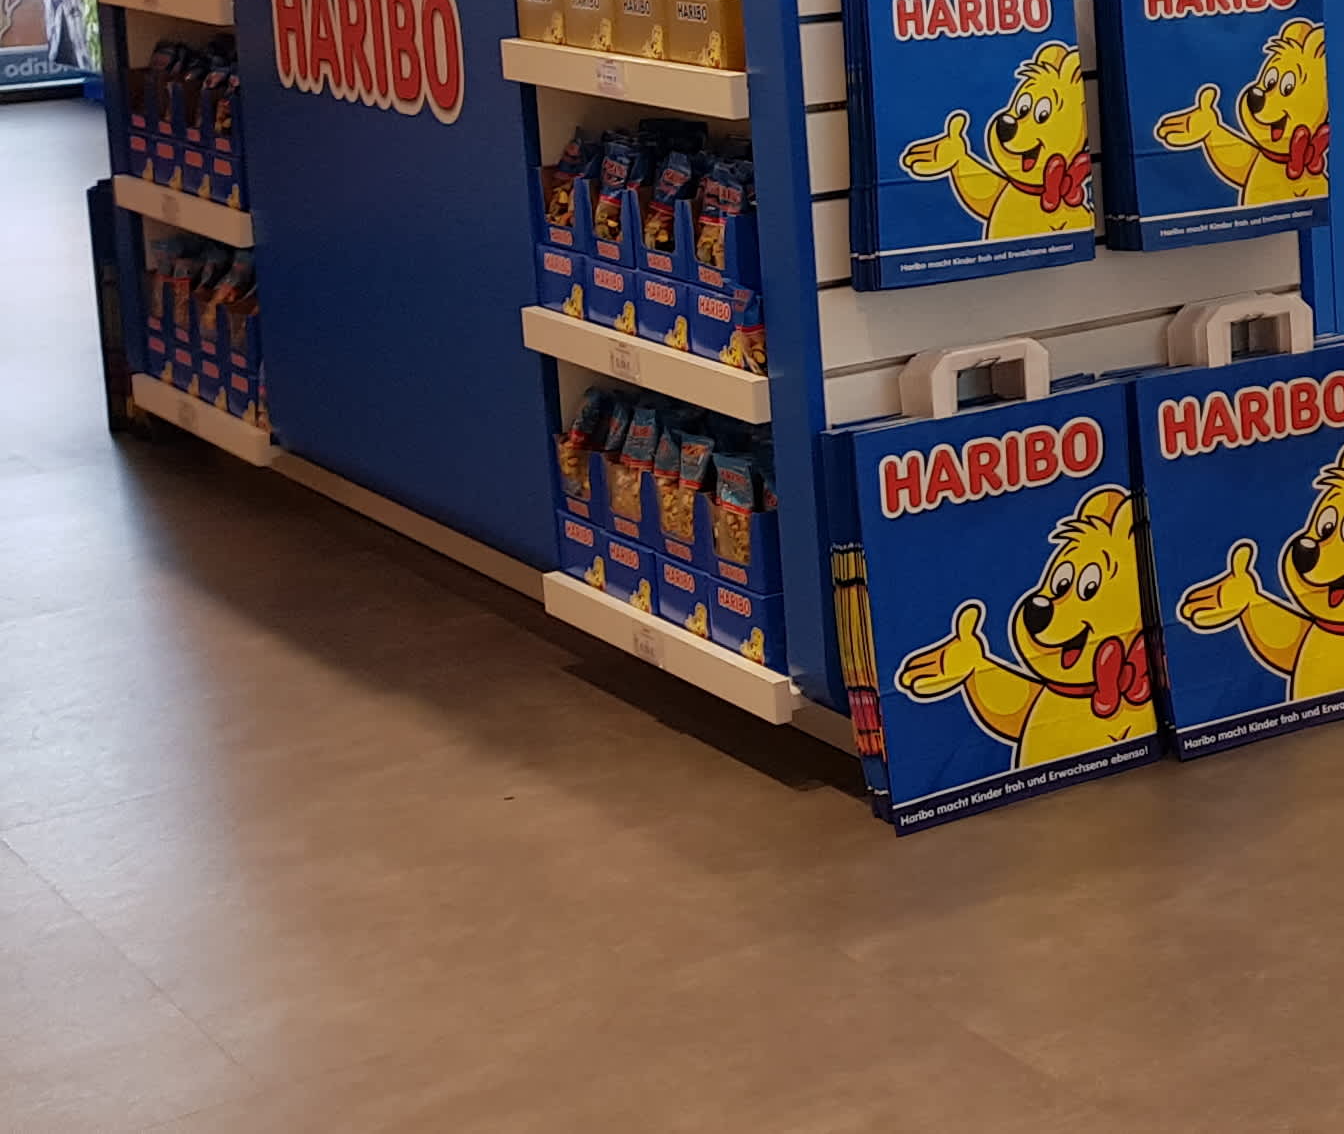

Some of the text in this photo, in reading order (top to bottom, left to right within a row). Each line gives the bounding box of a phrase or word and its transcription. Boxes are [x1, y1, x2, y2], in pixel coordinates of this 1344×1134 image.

[676, 1, 709, 24] HARIBO
[698, 295, 732, 322] HARIBO
[880, 417, 1103, 518] HARIBO
[609, 541, 639, 570] HARIBO
[664, 564, 695, 594] HARIBO
[717, 587, 751, 618] HARIBO
[1184, 734, 1216, 750] Haribo
[1217, 725, 1248, 741] macht
[1249, 717, 1279, 734] Kinder
[1280, 712, 1300, 725] froh
[1301, 706, 1321, 719] und
[901, 746, 1149, 827] Haribo macht Kinder froh und Erwachsene ebenso!
